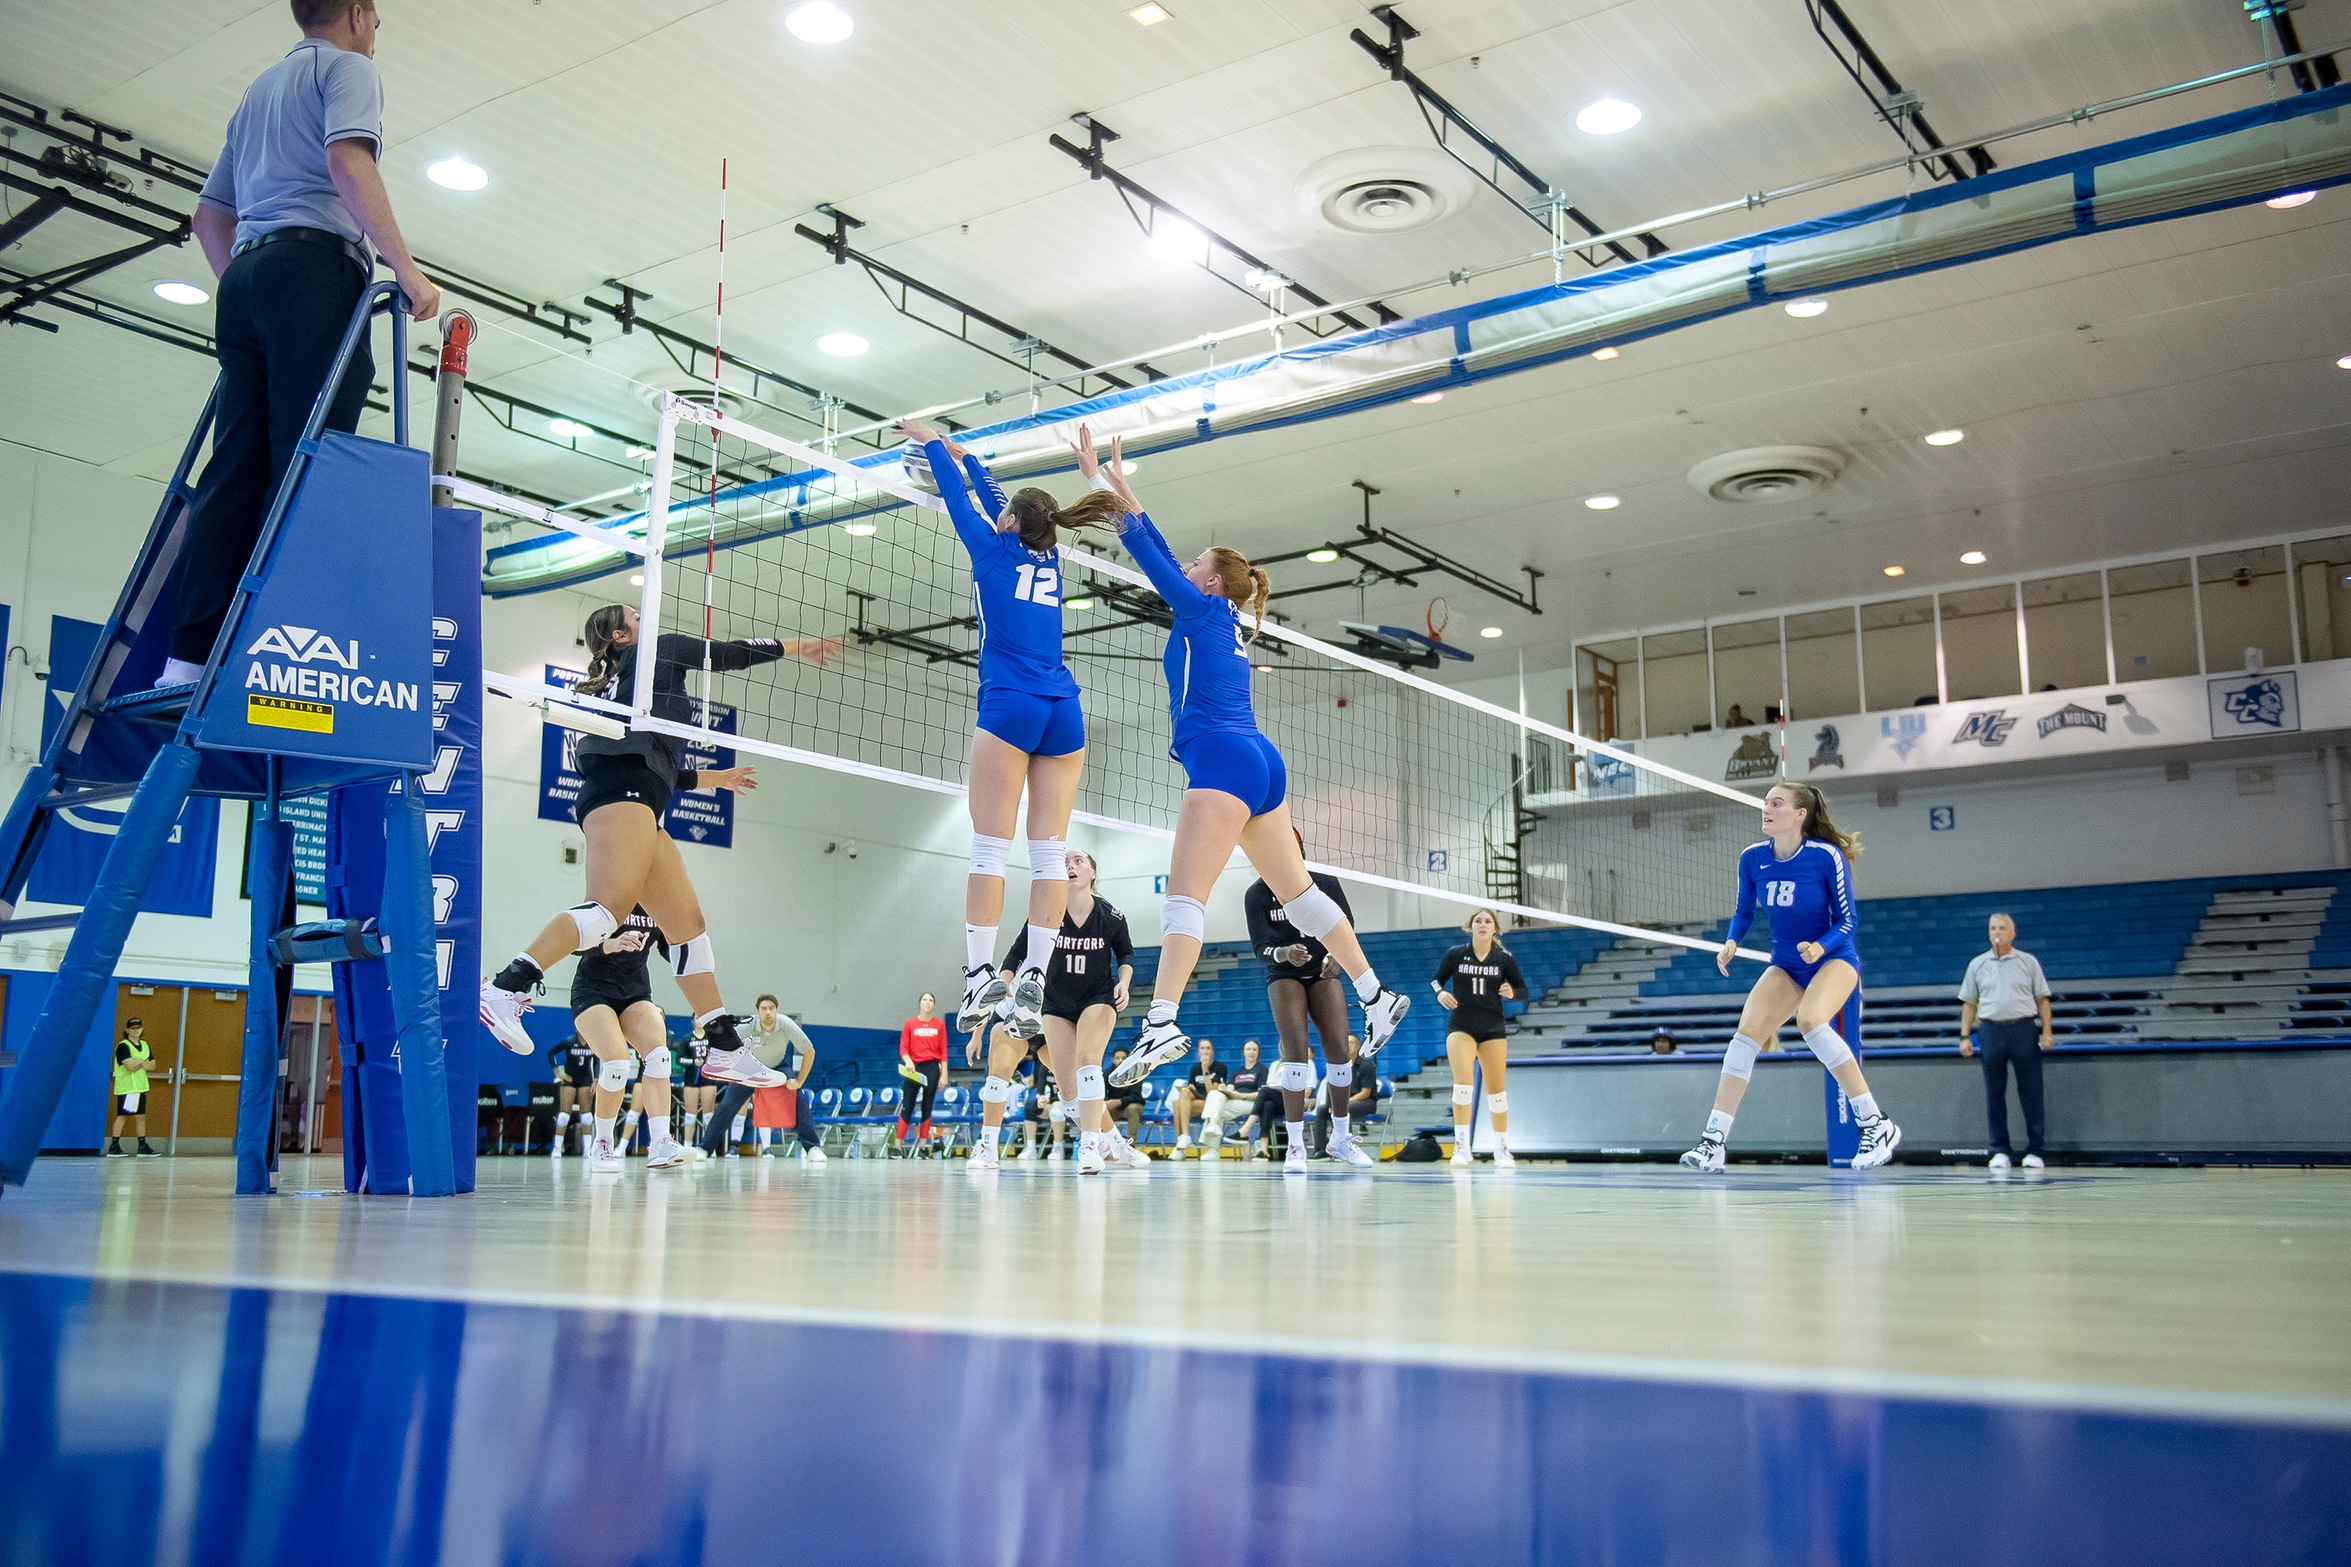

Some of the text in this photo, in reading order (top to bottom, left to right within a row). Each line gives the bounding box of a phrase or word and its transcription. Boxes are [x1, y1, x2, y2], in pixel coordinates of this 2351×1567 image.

[1014, 563, 1059, 608] 12
[245, 661, 418, 712] AMERICAN
[259, 697, 324, 713] WARNING
[283, 806, 310, 817] ISLAND
[680, 798, 720, 813] WOMEN'S
[671, 809, 726, 826] BASKETBALL
[1932, 807, 1952, 830] 3
[292, 821, 326, 832] ERRIMAC
[295, 859, 307, 868] CIS
[296, 872, 325, 884] FRANCI
[295, 885, 318, 895] GNER
[1766, 880, 1796, 907] 18
[623, 913, 658, 928] ARTFO
[1056, 935, 1105, 951] ARTFORD
[1065, 954, 1087, 975] 10
[1458, 964, 1499, 976] HARTFORD
[1471, 977, 1485, 996] 11
[478, 1097, 498, 1106] olten
